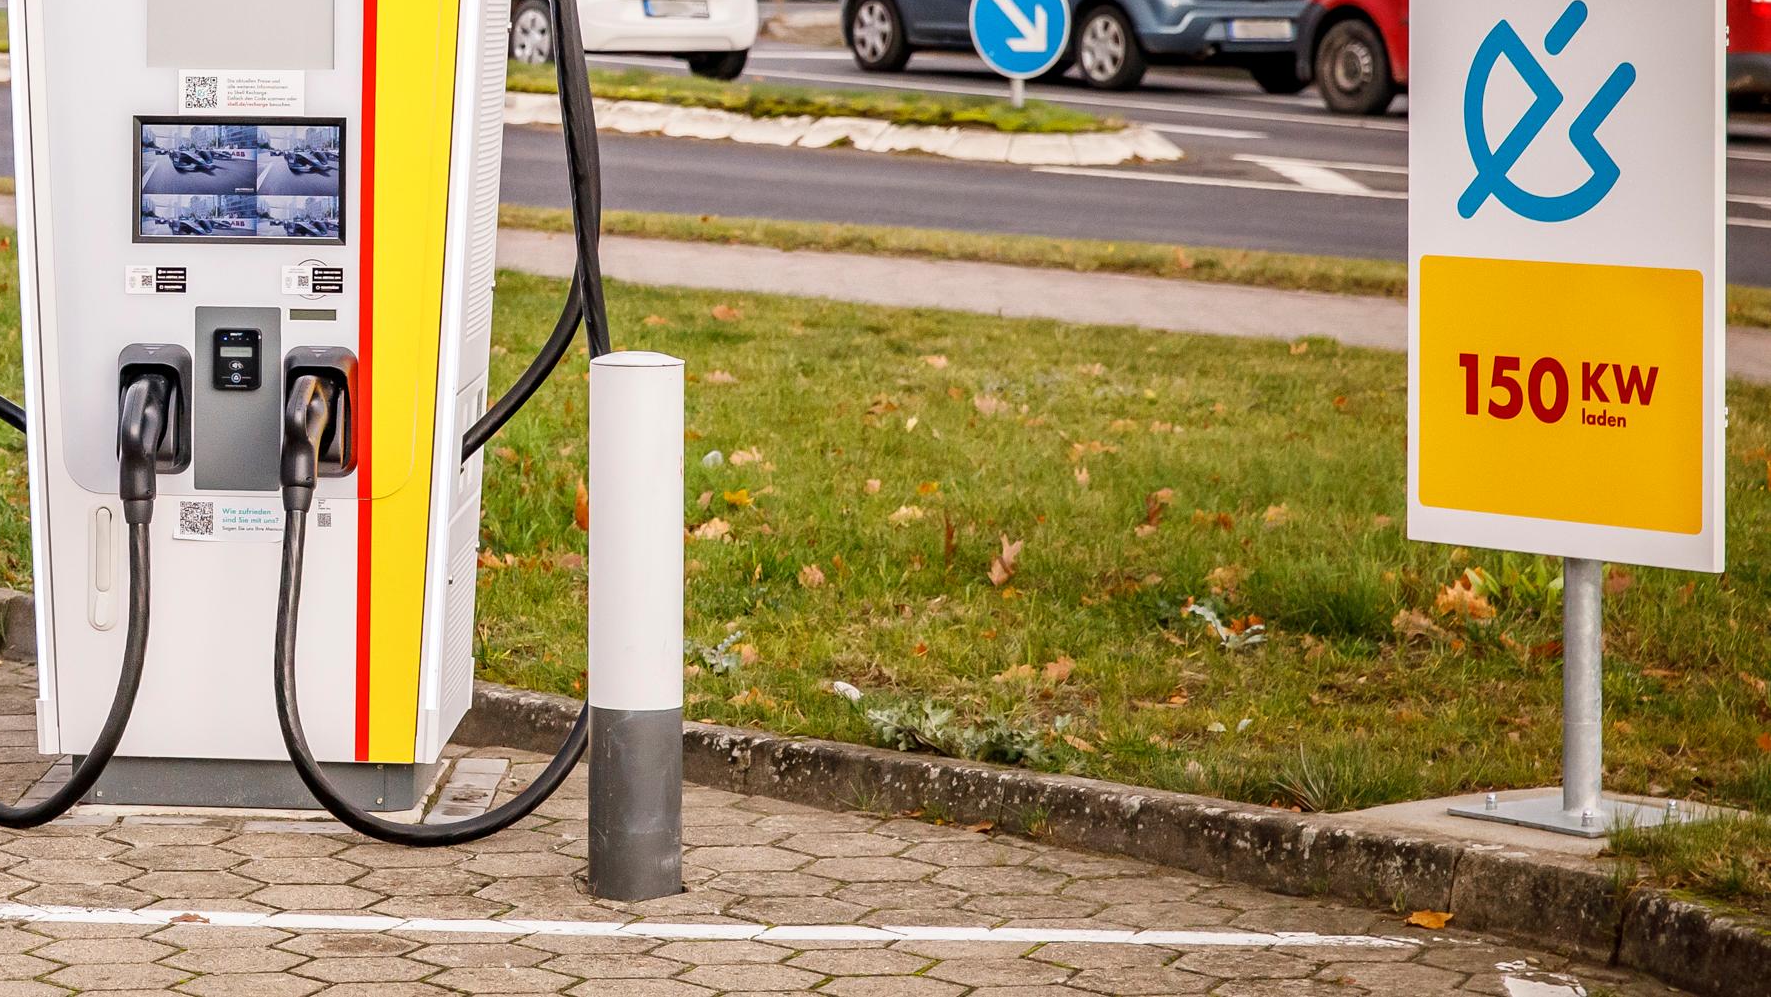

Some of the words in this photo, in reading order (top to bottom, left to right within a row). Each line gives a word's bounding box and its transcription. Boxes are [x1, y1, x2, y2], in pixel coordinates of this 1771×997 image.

[1459, 353, 1569, 424] 150
[1581, 362, 1659, 406] KW
[1582, 408, 1627, 428] laden
